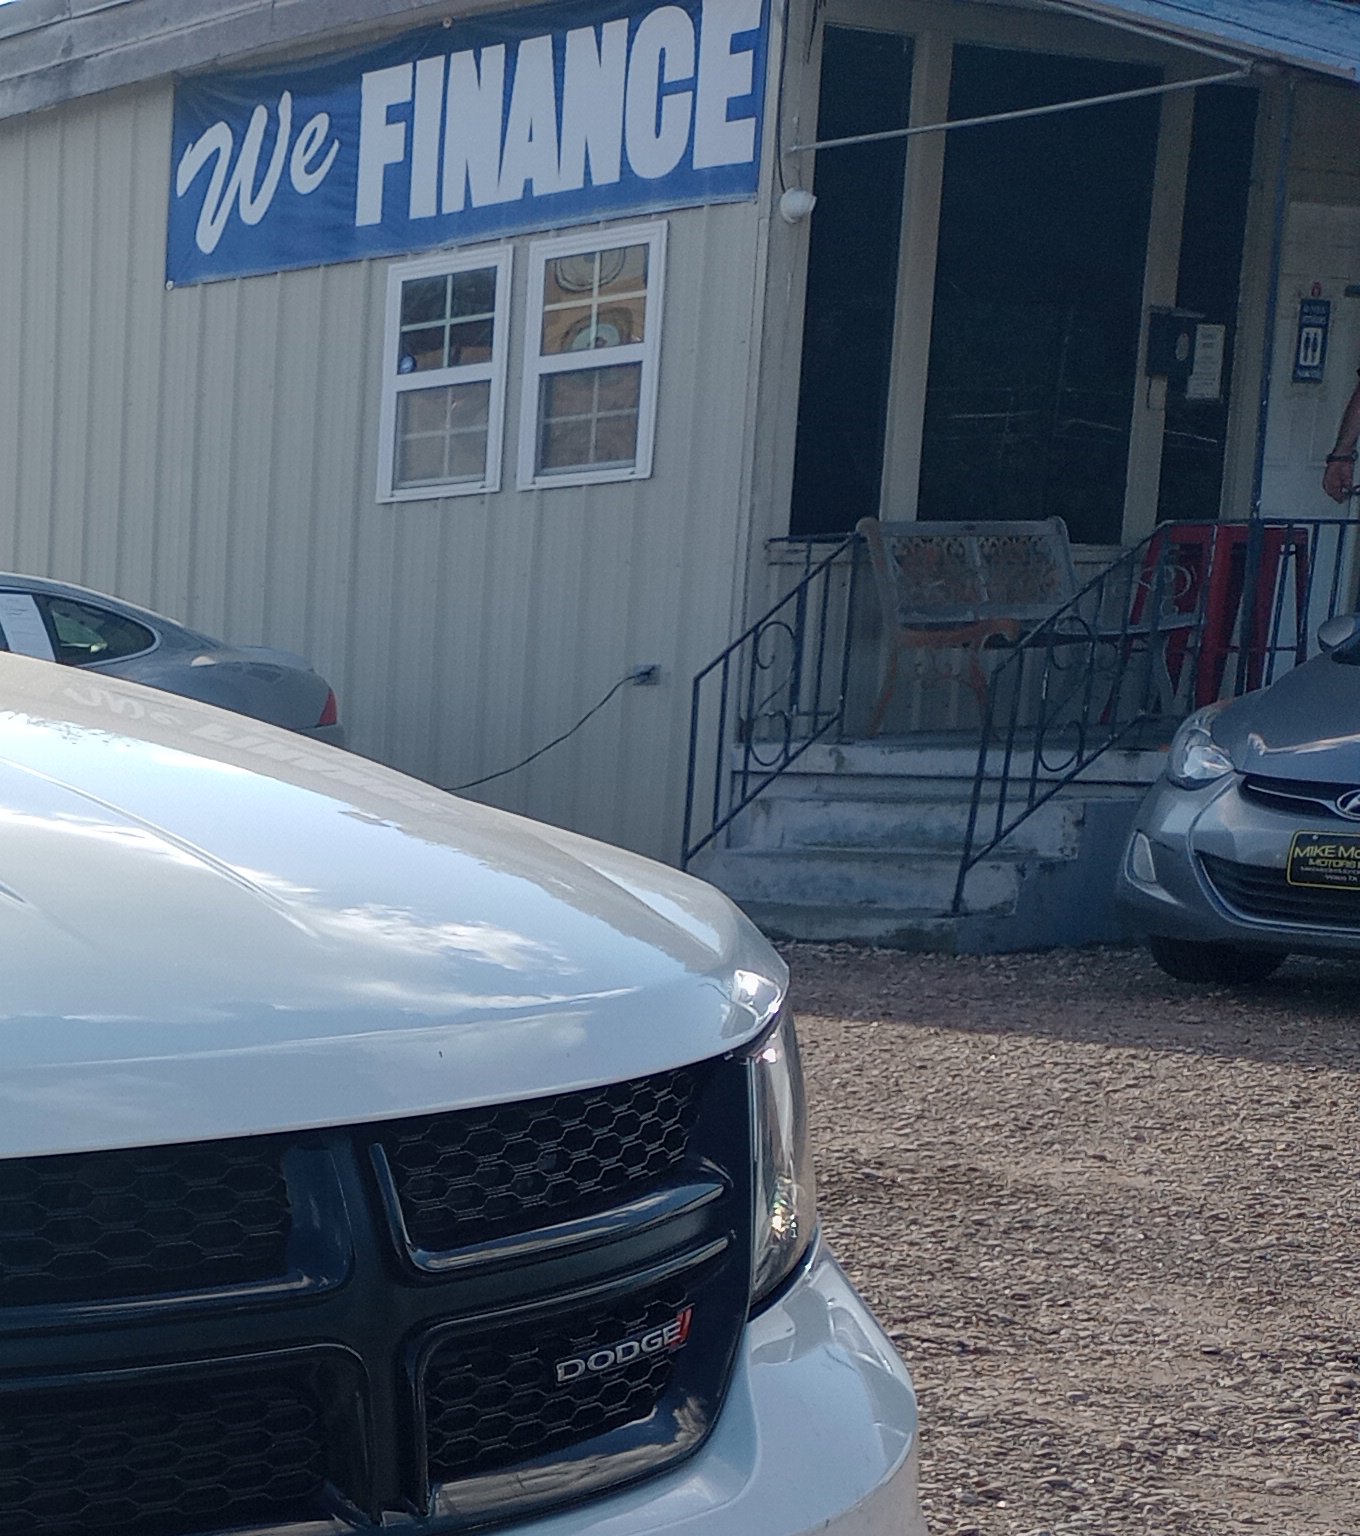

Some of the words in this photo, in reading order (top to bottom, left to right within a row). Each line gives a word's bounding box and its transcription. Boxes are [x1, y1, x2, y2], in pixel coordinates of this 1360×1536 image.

[176, 90, 340, 255] We
[355, 0, 763, 227] FINANCE
[1293, 845, 1336, 858] MIKE
[556, 1321, 681, 1382] DODGE
